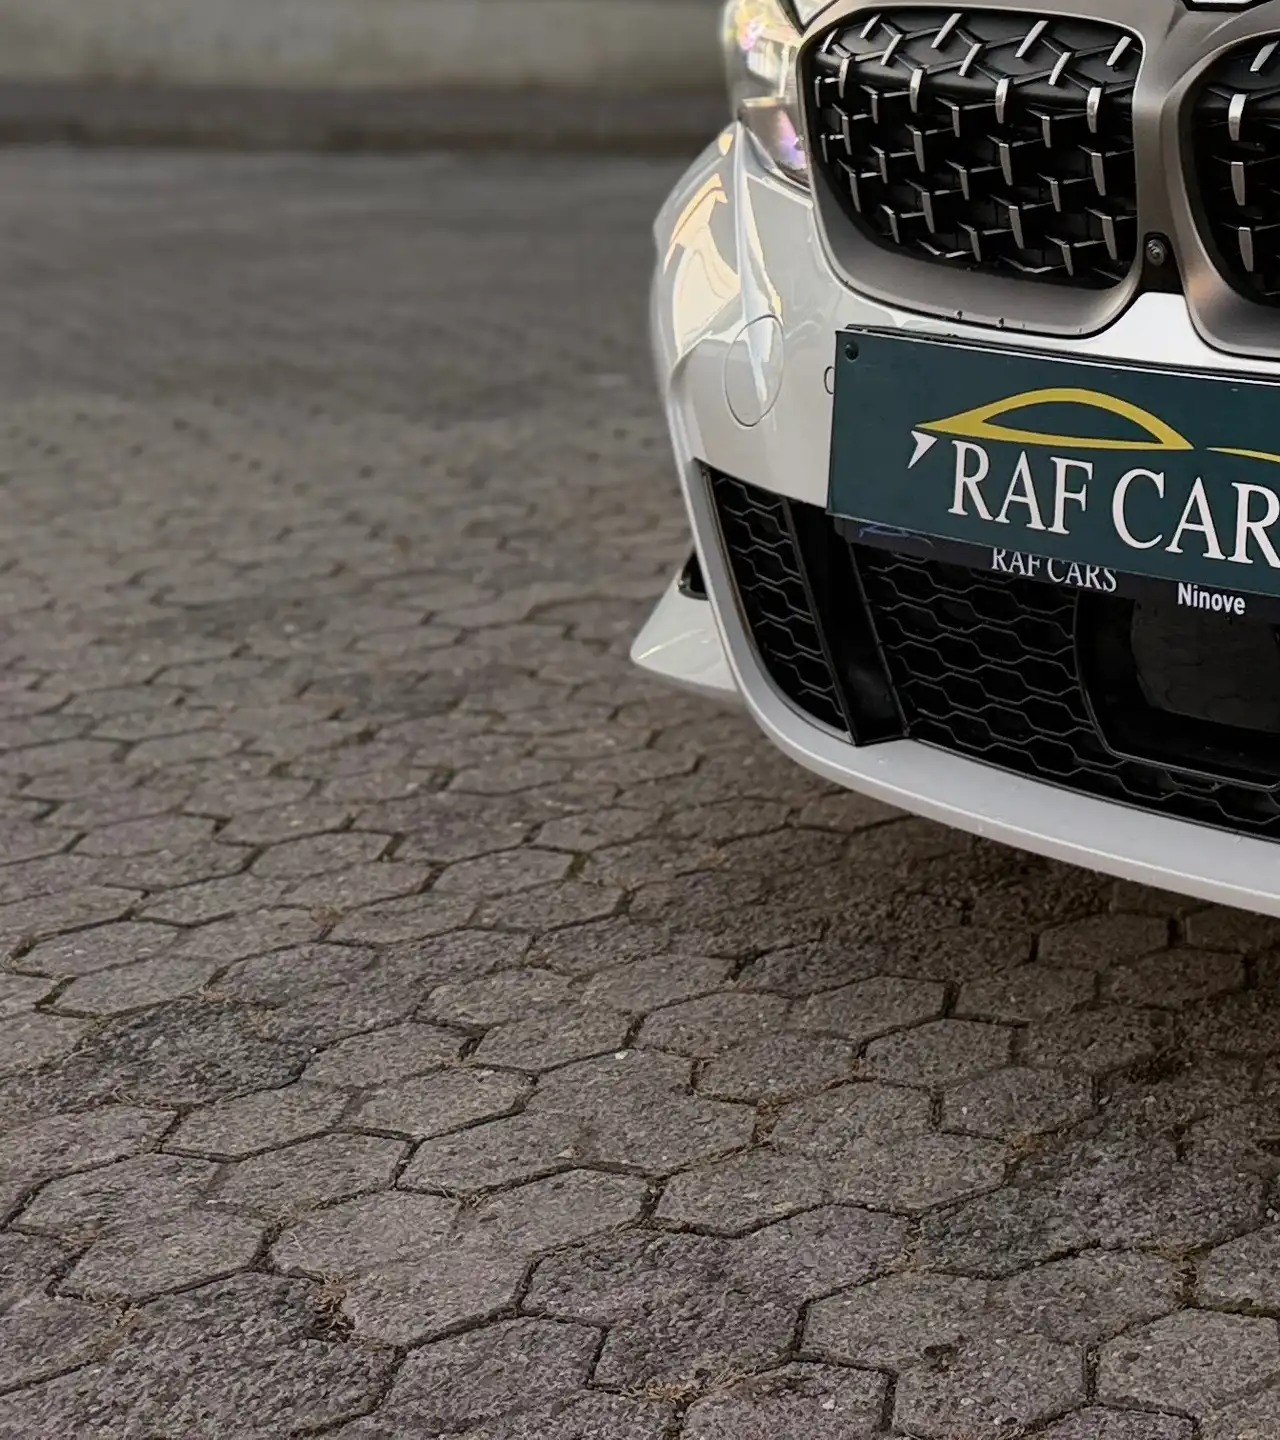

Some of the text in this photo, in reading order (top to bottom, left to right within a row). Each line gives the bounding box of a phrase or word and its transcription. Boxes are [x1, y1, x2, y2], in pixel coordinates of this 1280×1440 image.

[947, 439, 1094, 535] RAF
[991, 546, 1118, 593] RAF CARS
[1177, 582, 1246, 615] Ninove
